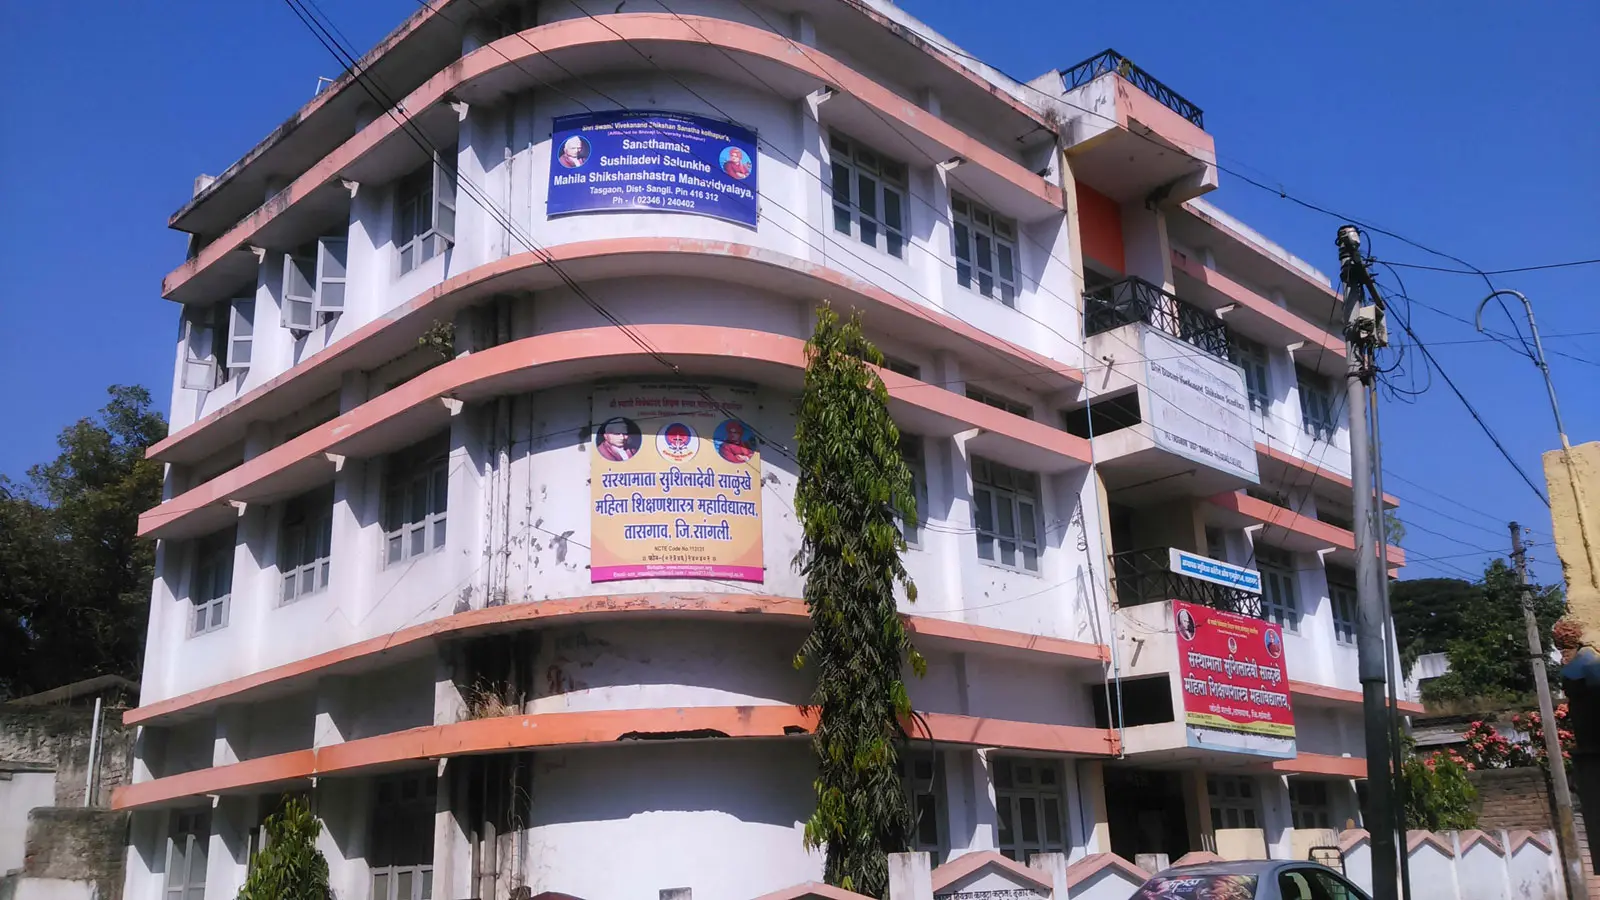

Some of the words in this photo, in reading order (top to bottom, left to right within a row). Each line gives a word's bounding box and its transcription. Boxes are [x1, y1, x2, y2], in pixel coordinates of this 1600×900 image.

[614, 121, 647, 129] Vivekanand
[649, 121, 675, 130] Shikshan
[676, 124, 699, 134] Sanstha
[622, 138, 690, 154] Sansthamata
[600, 154, 661, 166] Sushiladevi
[663, 154, 711, 173] Salunkhe
[554, 172, 586, 186] Mahila
[589, 169, 676, 183] Shikshanshastra
[678, 172, 754, 200] Mahavidyalaya,
[590, 185, 624, 195] Tasgaon,
[675, 186, 688, 196] Pin
[689, 188, 704, 199] 416
[705, 192, 719, 202] 312
[667, 197, 695, 208] 240402
[602, 468, 656, 488] संस्थामाता
[660, 466, 715, 492] सुशिलादेवी
[718, 470, 752, 495] साळुंखे
[595, 494, 628, 515] महिला
[632, 492, 694, 513] शिक्षणशास्त्र
[1188, 646, 1223, 672] संस्थामाता
[1223, 654, 1258, 679] सुशिलादेवी
[1259, 662, 1282, 687] साळुंखे
[1184, 672, 1207, 696] महिला
[1207, 675, 1249, 702] शिक्षणशास्त्र
